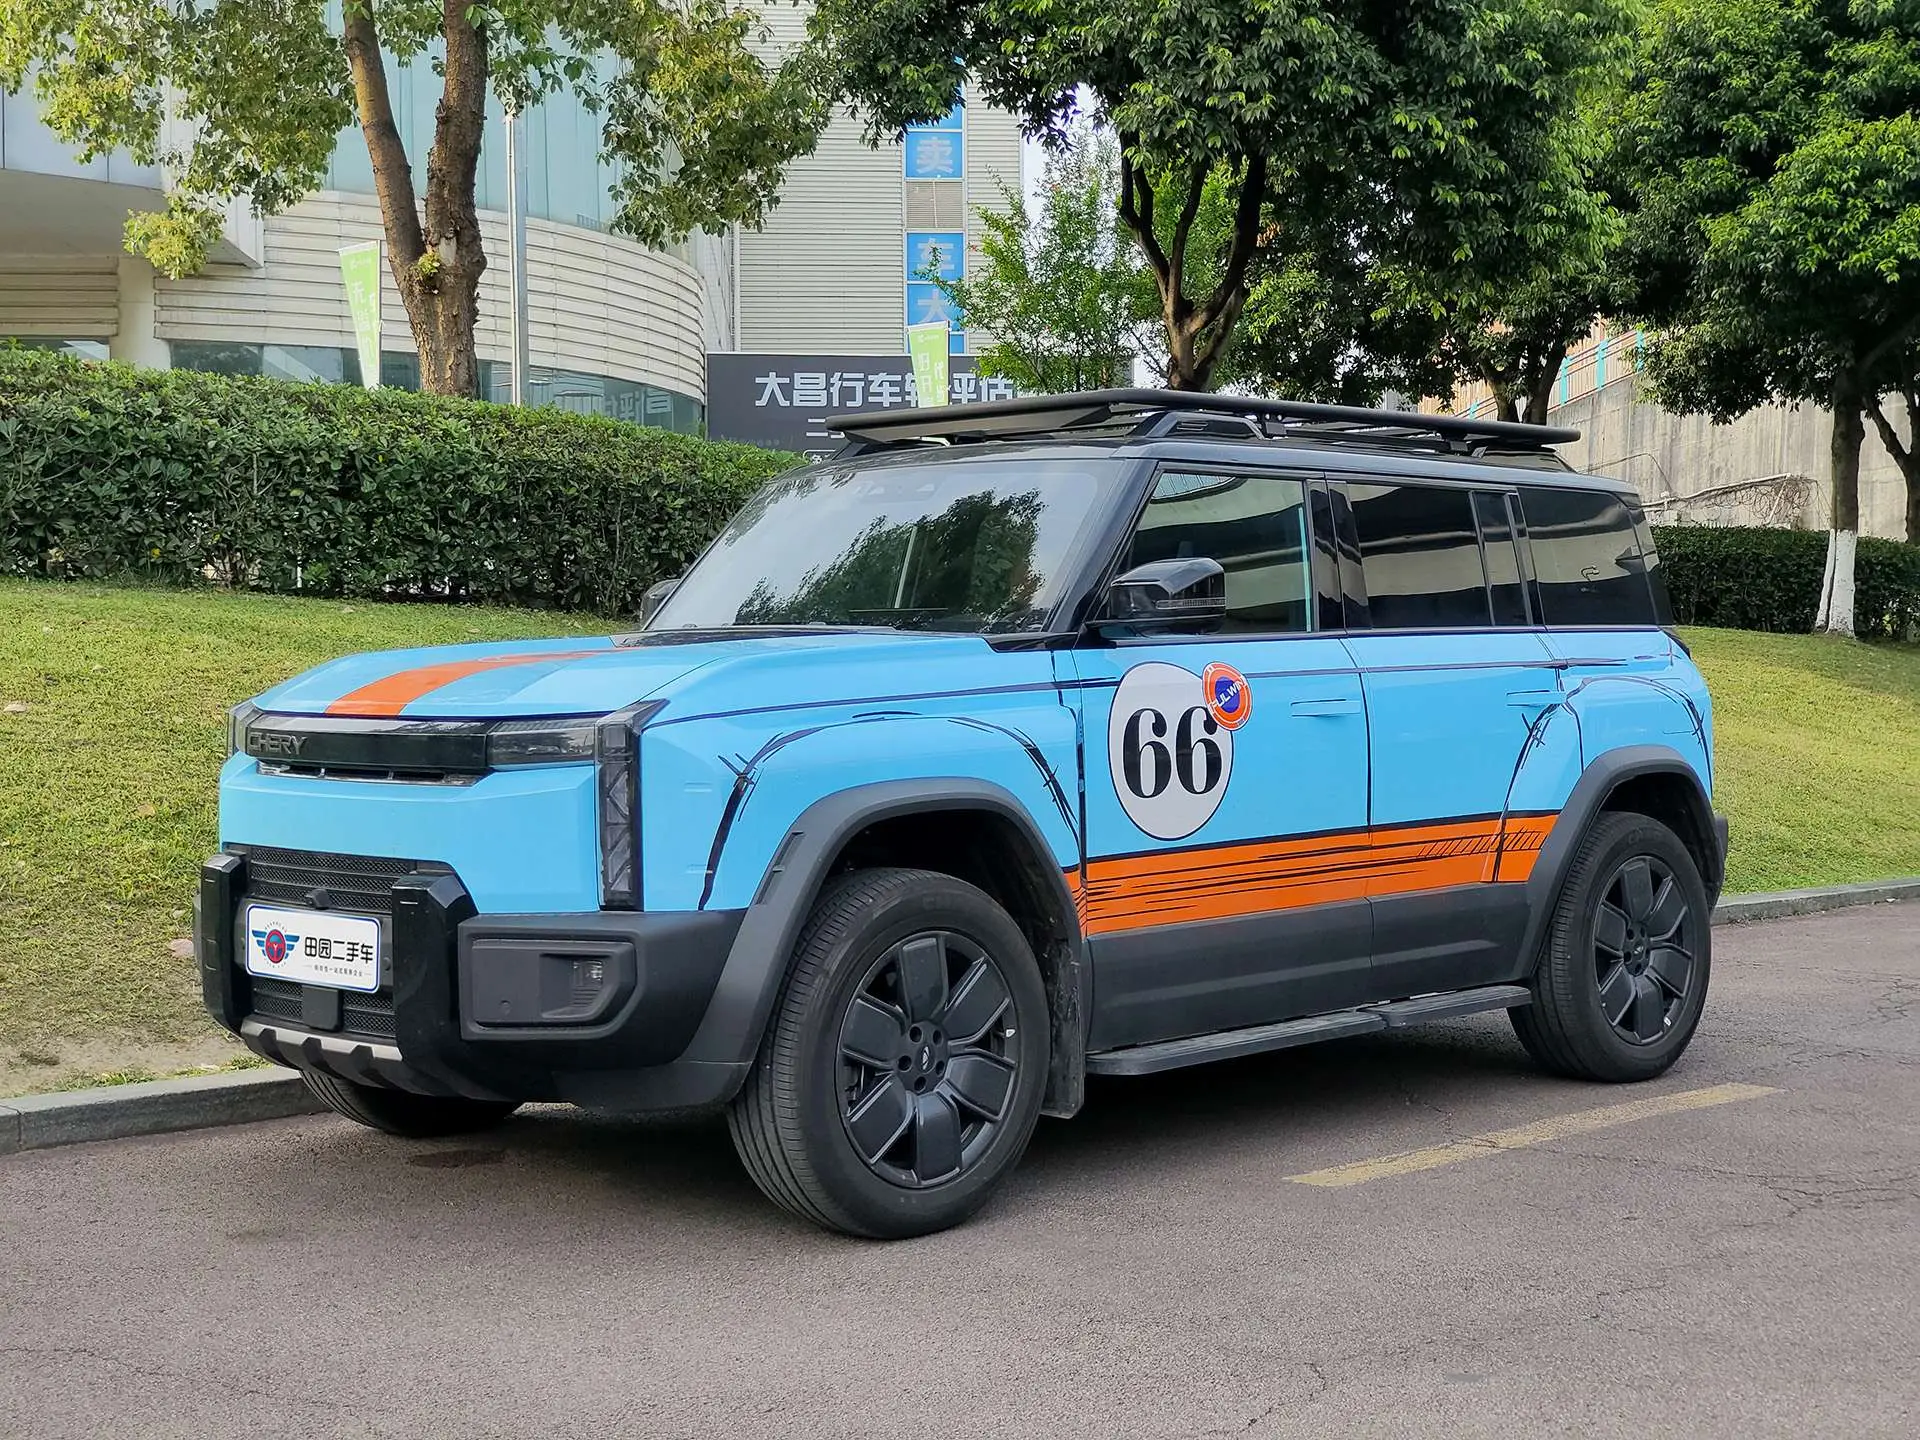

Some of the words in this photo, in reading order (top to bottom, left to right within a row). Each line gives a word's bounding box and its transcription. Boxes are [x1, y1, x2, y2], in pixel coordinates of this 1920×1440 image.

[247, 731, 308, 755] CHERY
[1123, 706, 1222, 798] 66
[304, 936, 374, 964] 田园二手车
